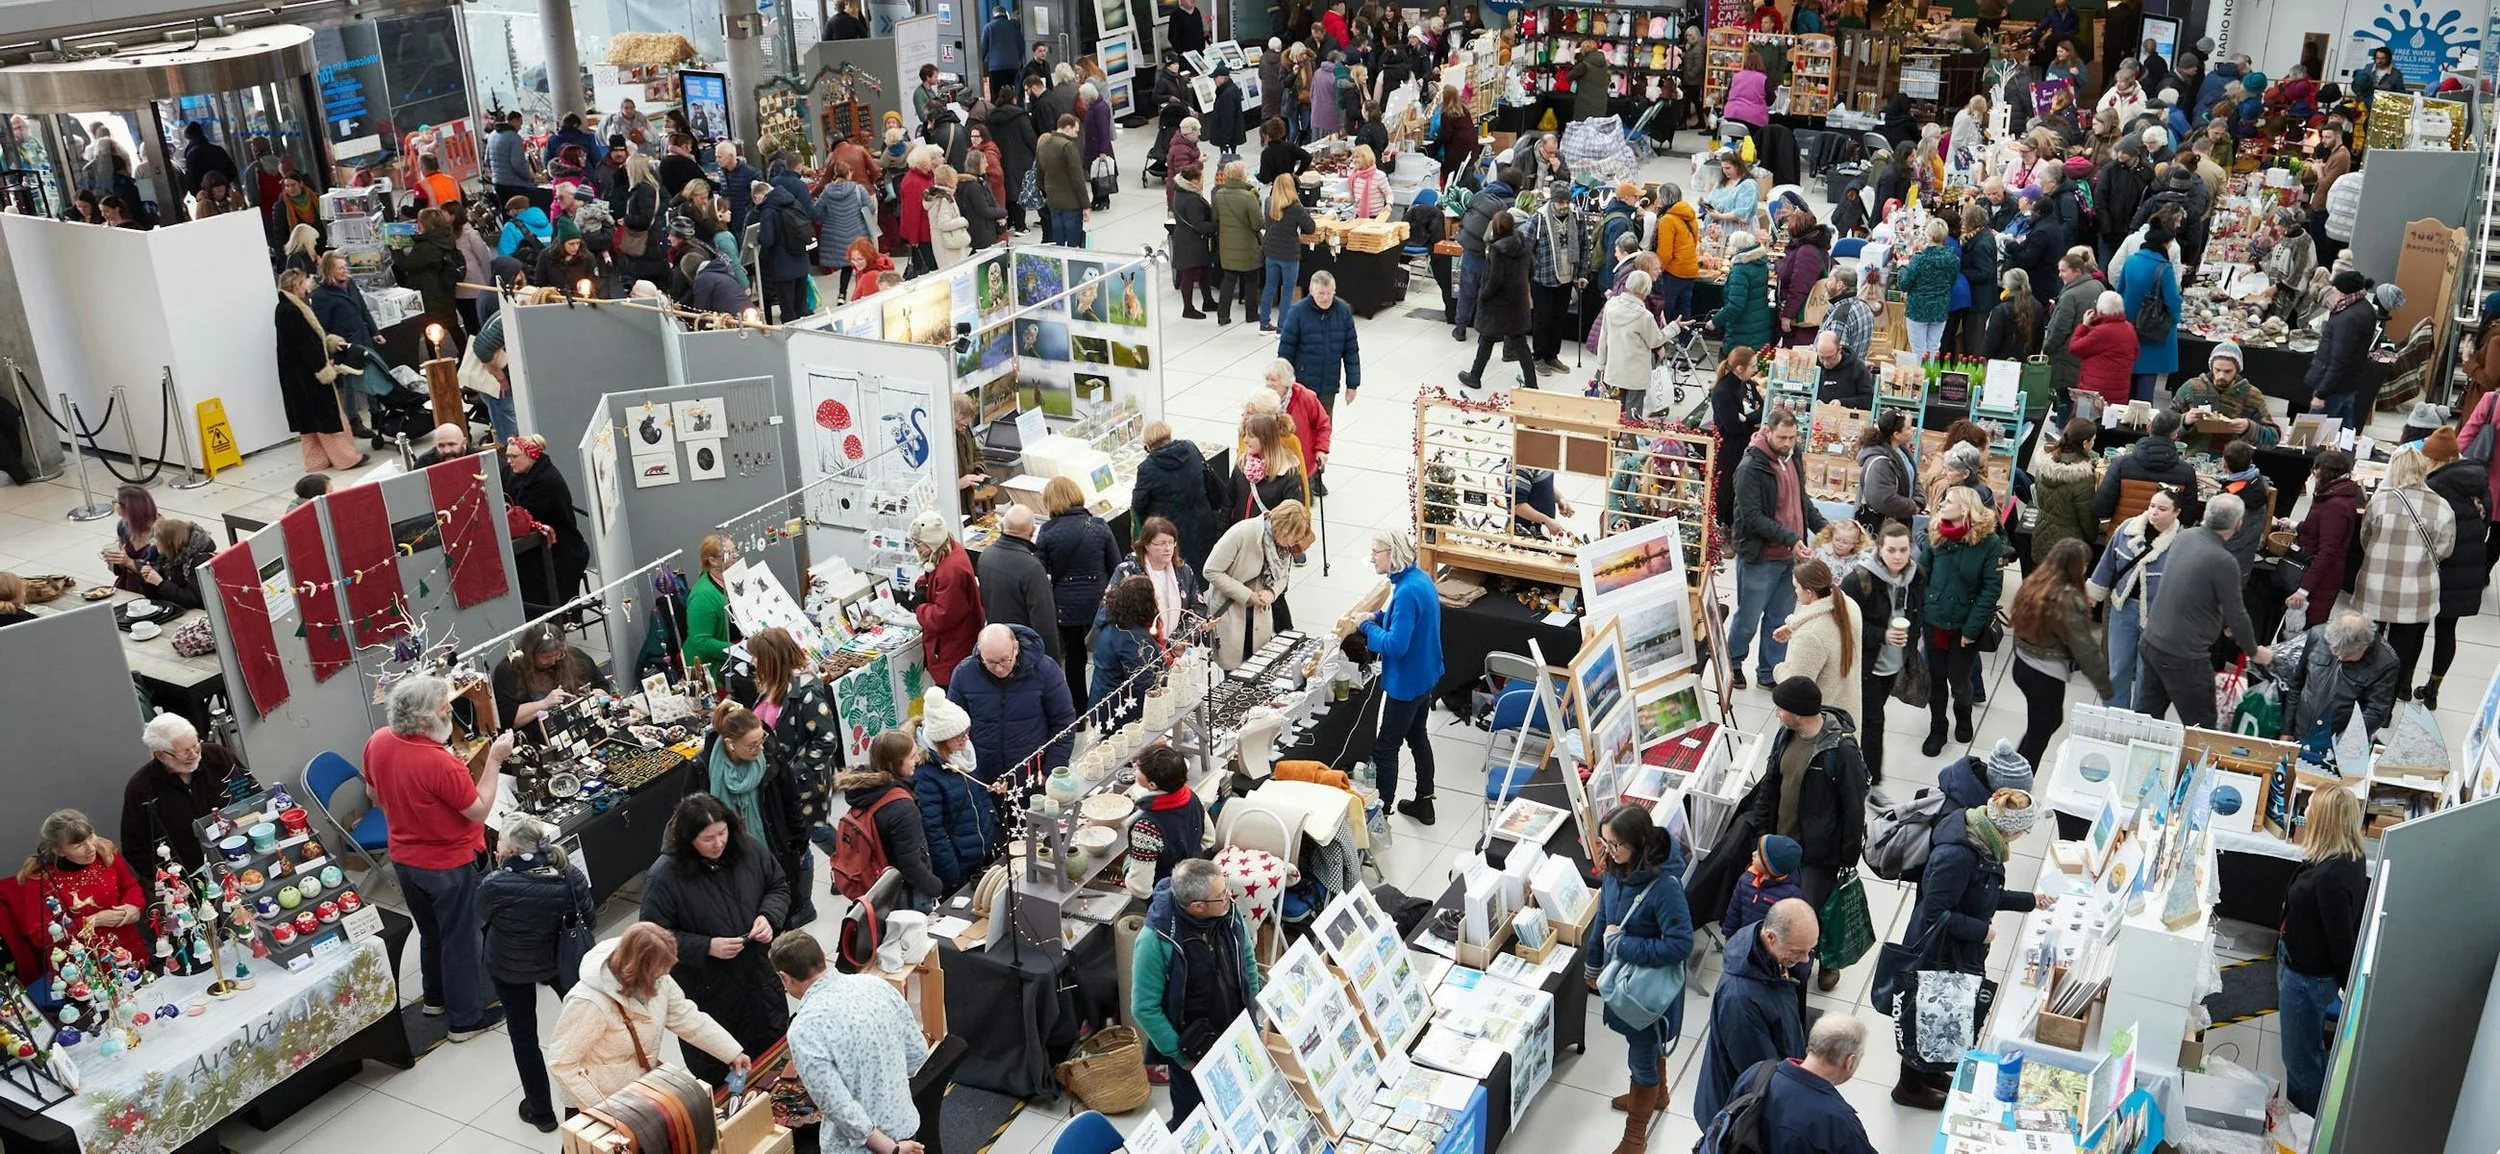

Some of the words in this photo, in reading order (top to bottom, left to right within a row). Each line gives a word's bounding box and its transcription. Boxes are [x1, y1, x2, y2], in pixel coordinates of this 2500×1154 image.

[1717, 10, 1738, 21] CAR
[2217, 20, 2230, 57] RADIO
[2394, 48, 2410, 56] FREE
[2412, 49, 2436, 57] WATER
[2418, 55, 2436, 63] HERE
[2410, 231, 2445, 245] 100%
